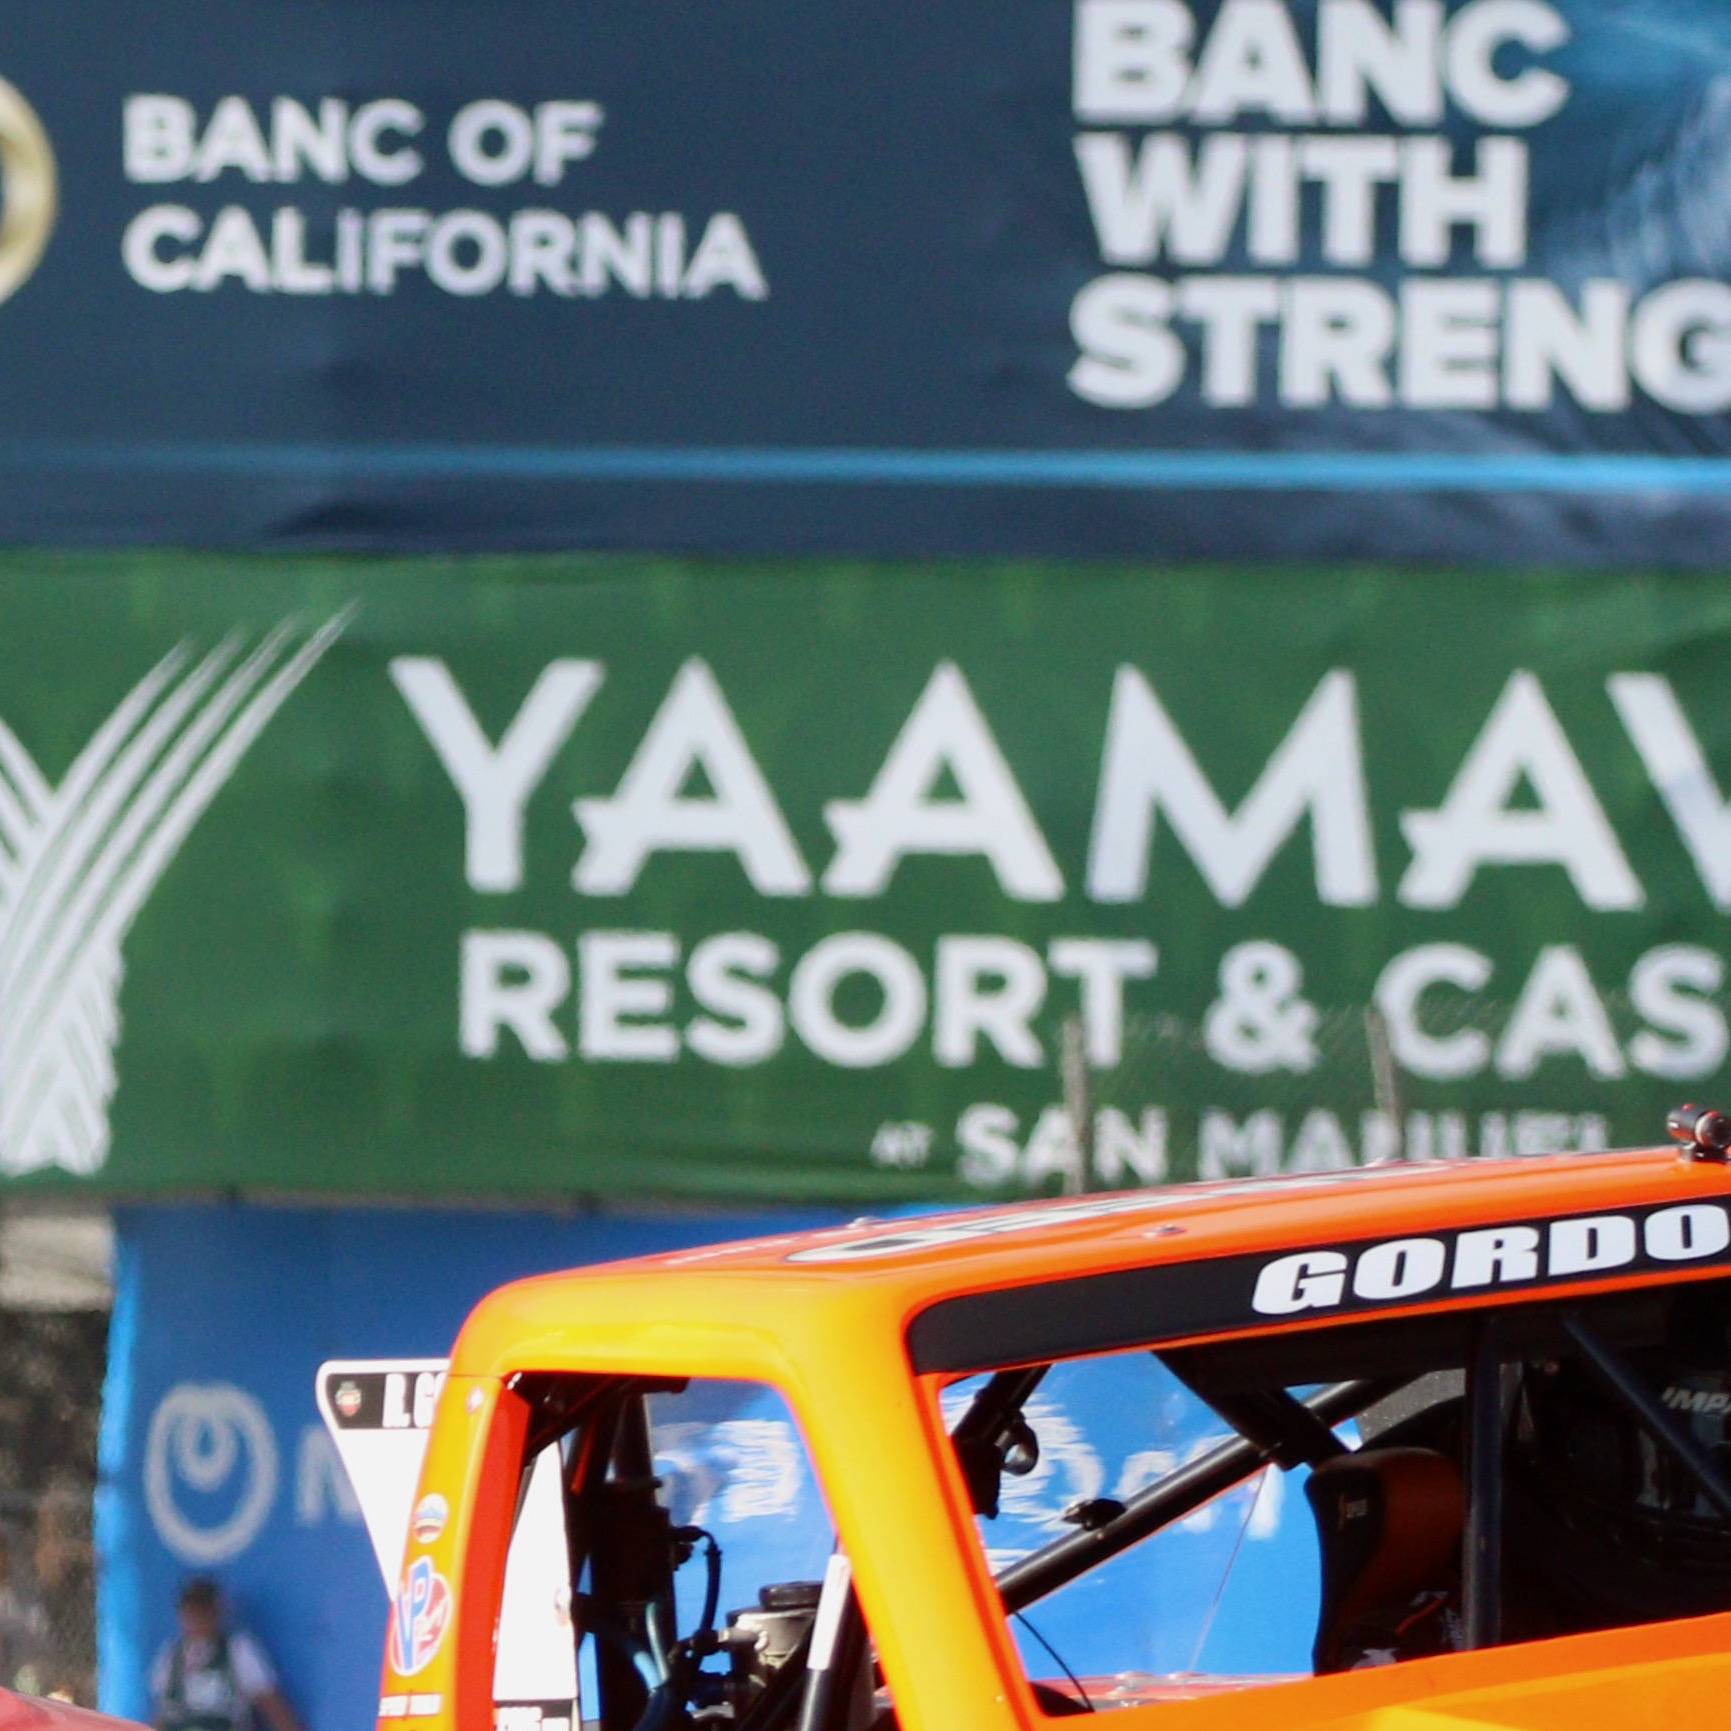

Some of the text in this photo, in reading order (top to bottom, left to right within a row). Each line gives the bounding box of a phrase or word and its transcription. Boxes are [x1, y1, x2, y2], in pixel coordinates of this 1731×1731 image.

[1072, 0, 1570, 127] BANC
[123, 93, 605, 185] BANC OF
[122, 204, 769, 301] CALIFORNIA
[1072, 131, 1529, 268] WITH
[459, 928, 1730, 1081] RESORT & CAS
[954, 1104, 1167, 1188] SAN
[1251, 1202, 1731, 1316] GORDO
